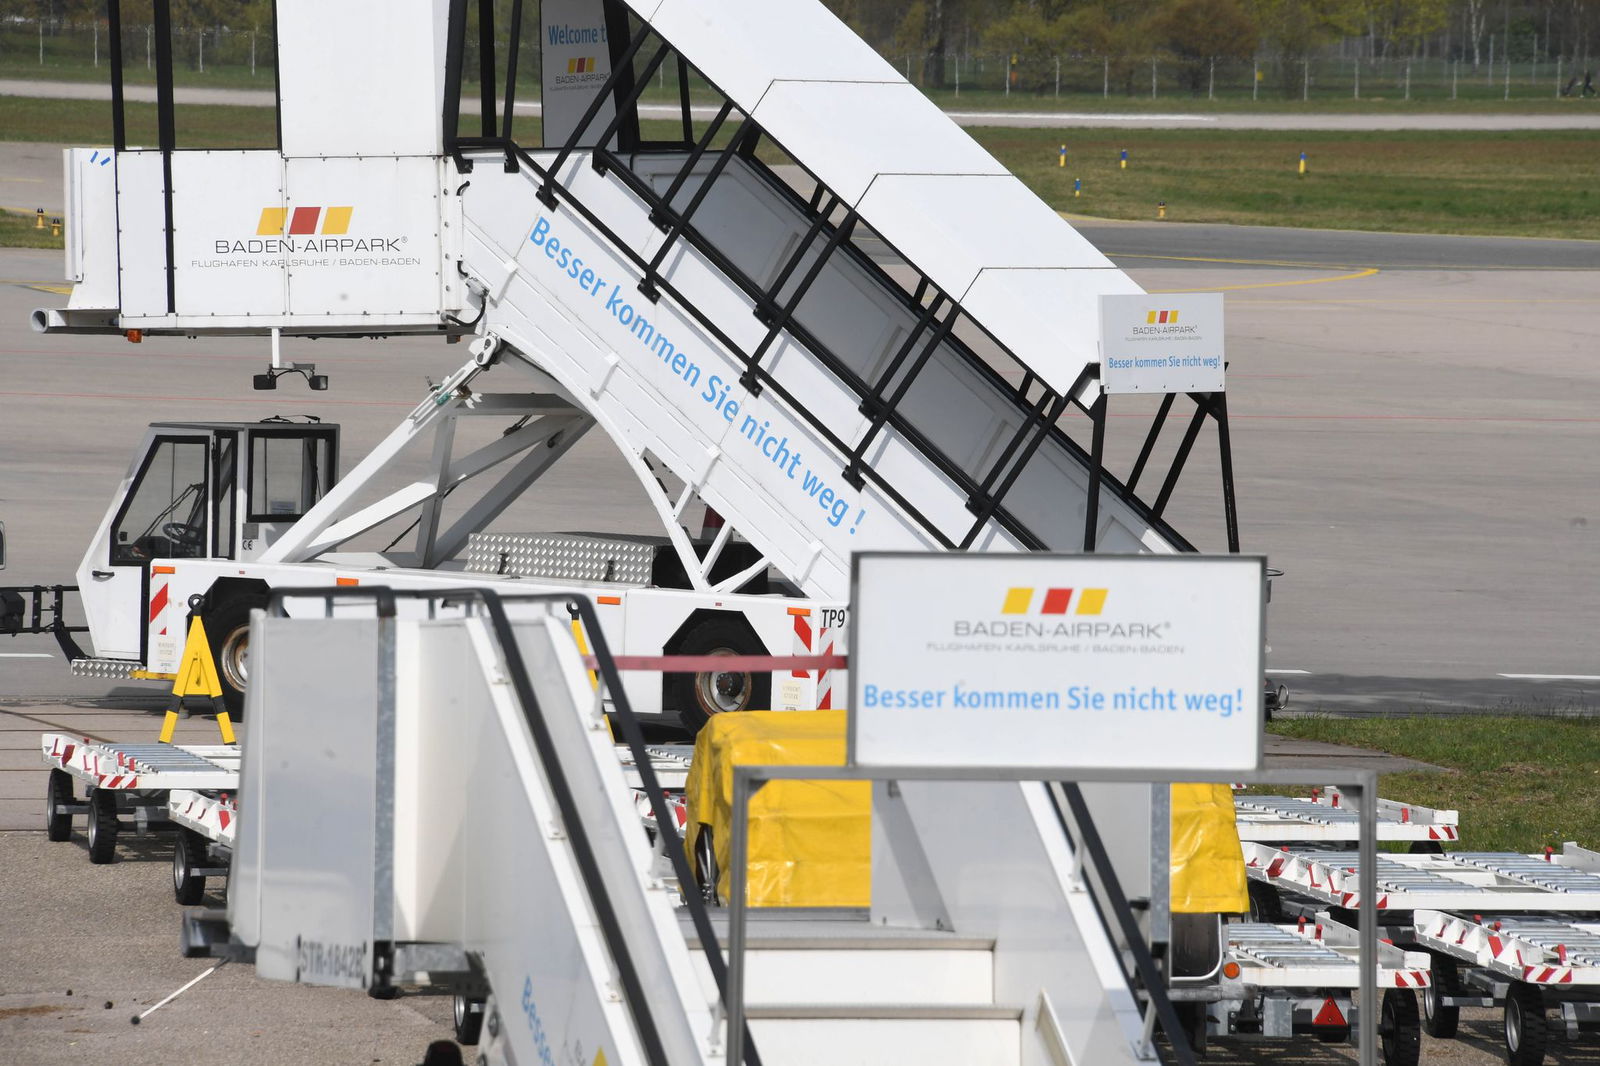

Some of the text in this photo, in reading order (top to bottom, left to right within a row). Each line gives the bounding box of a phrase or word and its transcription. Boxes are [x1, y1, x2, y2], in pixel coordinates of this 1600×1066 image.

[548, 24, 608, 45] Welcome t
[191, 259, 258, 268] FLUGHAFEN
[262, 258, 329, 267] KARLSRUHE
[340, 257, 421, 266] BADEN-BADEN
[530, 216, 607, 297] Besser
[605, 284, 701, 388] kommen
[701, 375, 740, 423] Sie
[740, 414, 802, 479] nicht
[1108, 354, 1221, 369] Besser kommen Sie nicht weg!
[242, 540, 253, 550] CE
[822, 609, 845, 628] TP9
[926, 642, 1001, 652] FLUGHAFEN
[1004, 642, 1081, 653] KARLSRUHE
[863, 684, 1243, 718] Besser kommen Sie nicht weg!
